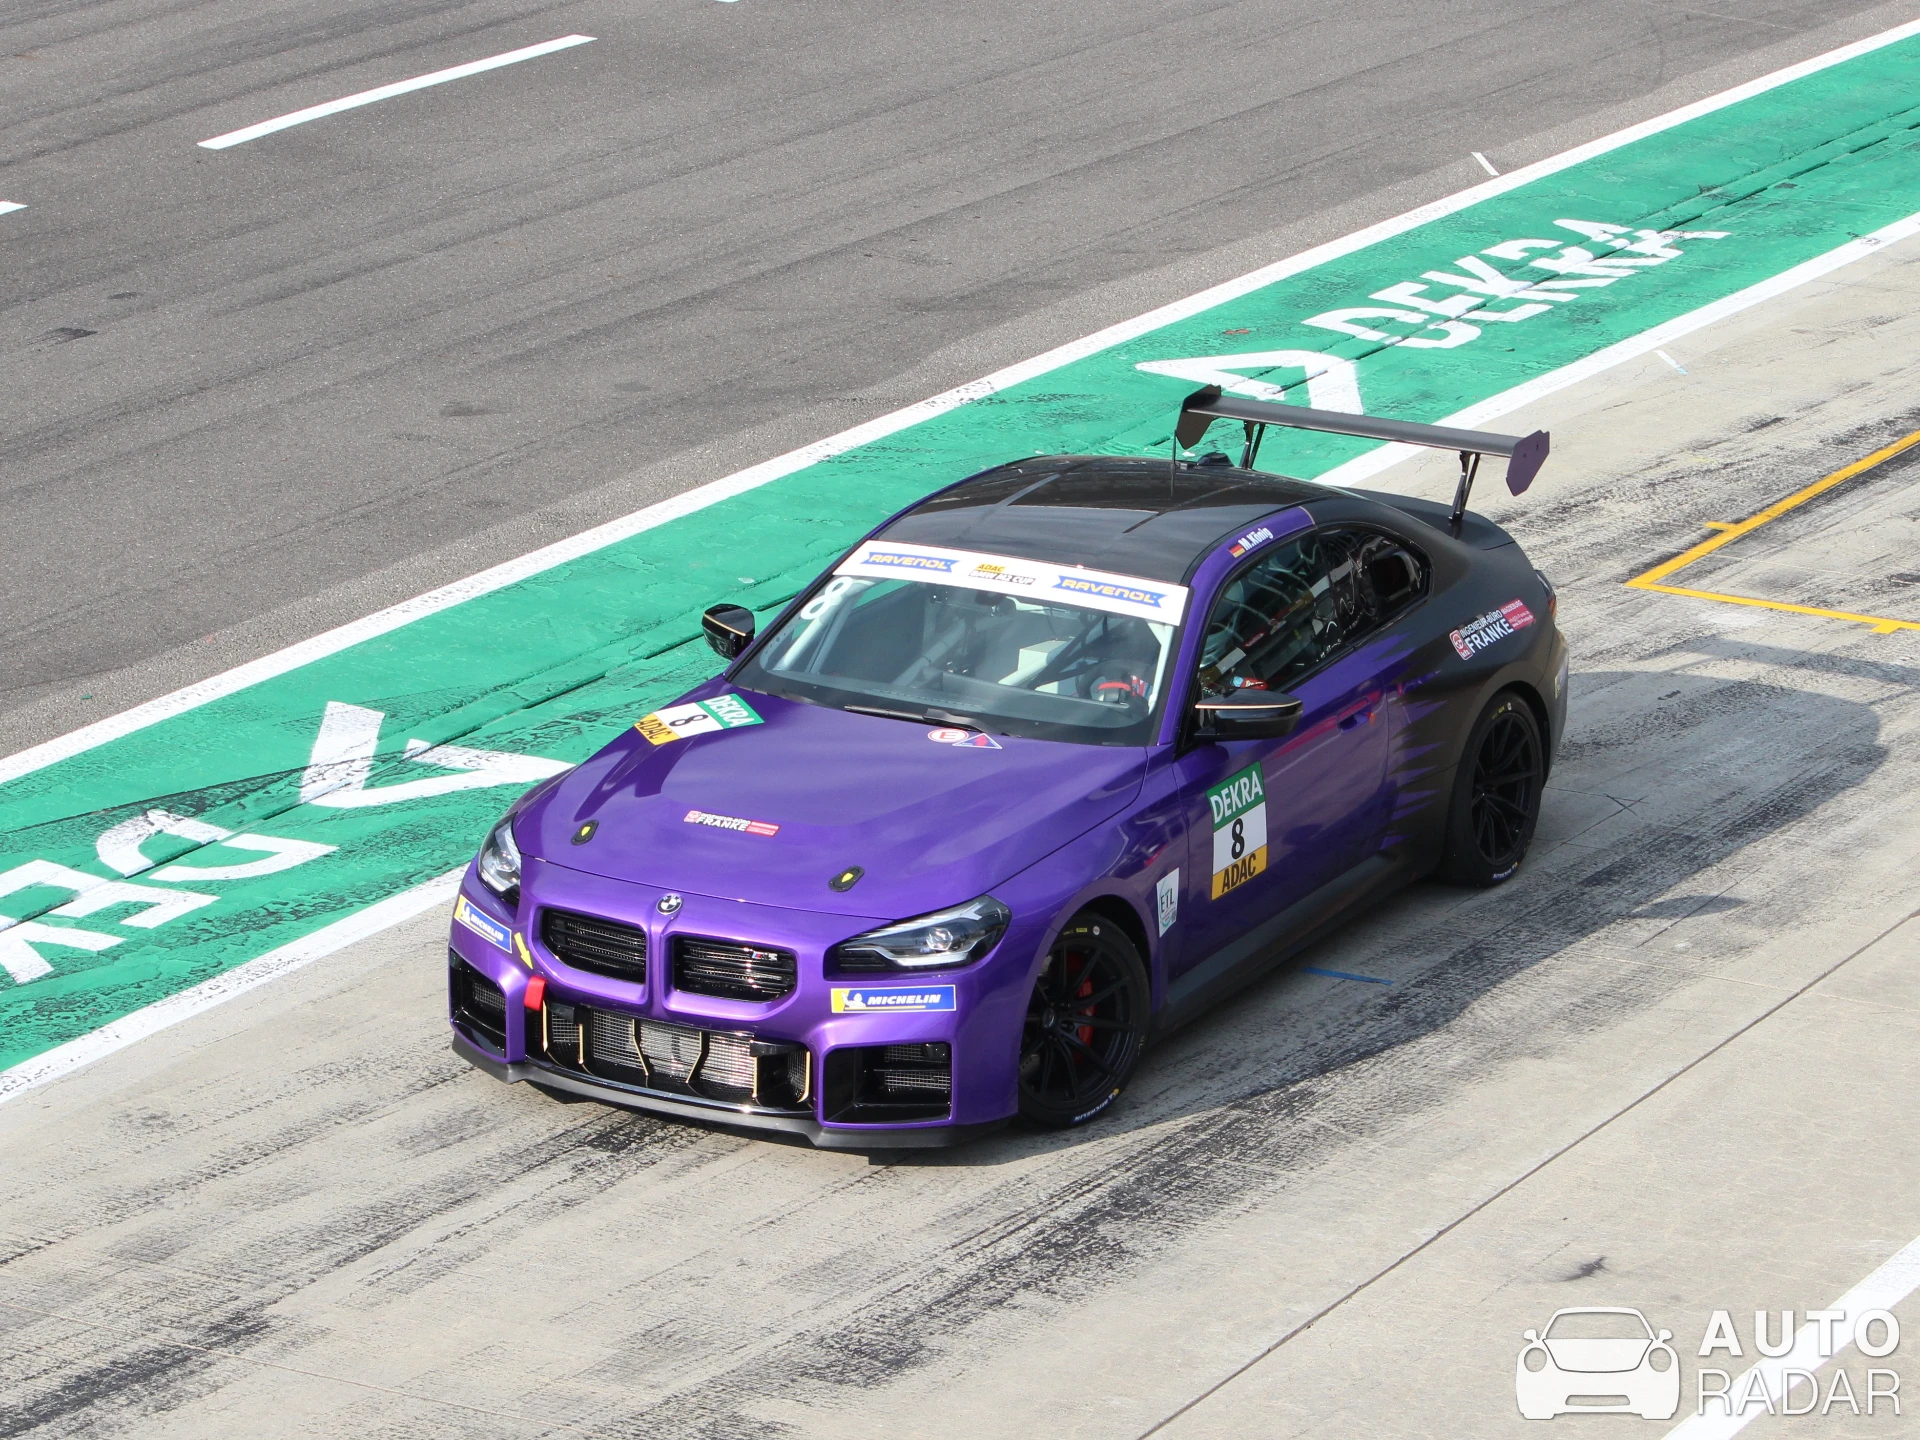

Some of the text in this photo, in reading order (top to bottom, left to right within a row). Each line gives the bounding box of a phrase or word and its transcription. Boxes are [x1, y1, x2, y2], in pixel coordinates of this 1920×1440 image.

[1300, 218, 1733, 349] DEKRA
[868, 553, 949, 570] RAVENOL
[976, 563, 1005, 574] ADAC
[969, 570, 1035, 585] BMW M2 CUP
[800, 576, 853, 620] 8
[1061, 578, 1157, 605] RAVENOL
[1464, 618, 1515, 654] FRANKE
[668, 714, 709, 727] 8
[703, 694, 755, 727] DEKRA
[638, 718, 672, 740] ADAC
[939, 731, 961, 740] E
[1209, 770, 1263, 825] DEKRA
[695, 815, 750, 832] FRANKE
[1231, 817, 1245, 860] 8
[1221, 853, 1256, 894] ADAC
[0, 808, 342, 993] DEK
[1160, 887, 1175, 913] ETL
[470, 913, 505, 941] MICHELIN
[866, 993, 942, 1006] MICHELIN
